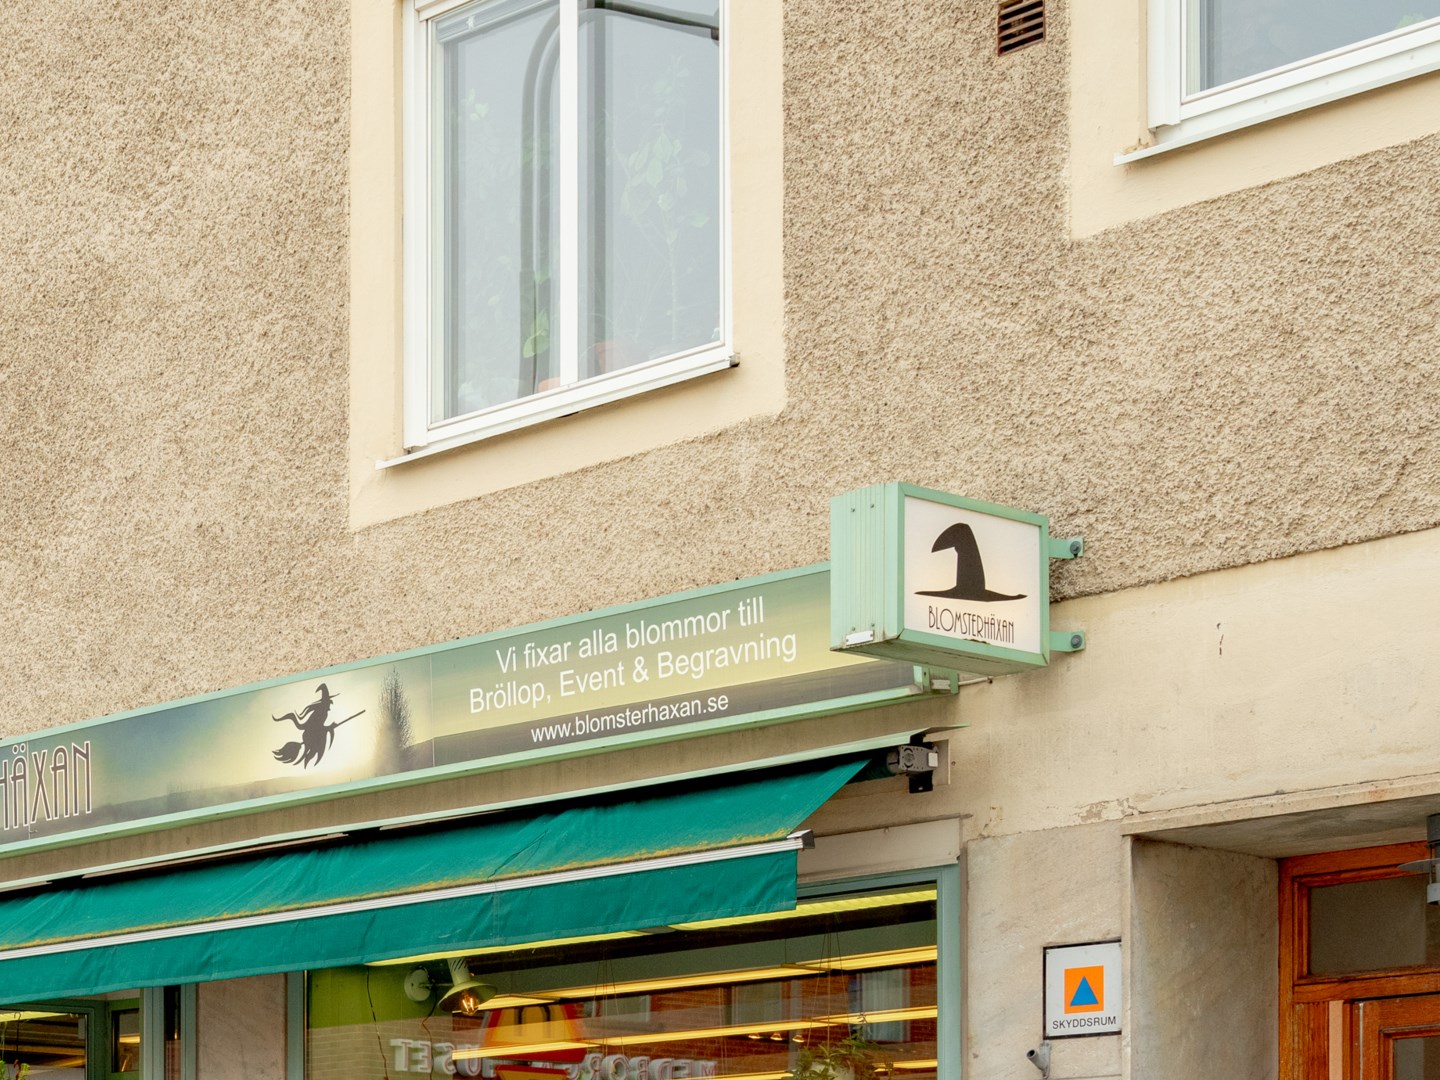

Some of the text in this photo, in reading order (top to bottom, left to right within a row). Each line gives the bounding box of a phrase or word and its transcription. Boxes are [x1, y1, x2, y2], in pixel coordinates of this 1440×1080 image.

[496, 595, 765, 674] Vi fixar alla blommor till
[928, 605, 1015, 644] BLOMSTERHÄXAN
[469, 632, 798, 714] Bröllop, Event & Begravning
[531, 694, 729, 743] www.blomsterhaxan.se
[1052, 1016, 1117, 1030] SKYDDSRUM
